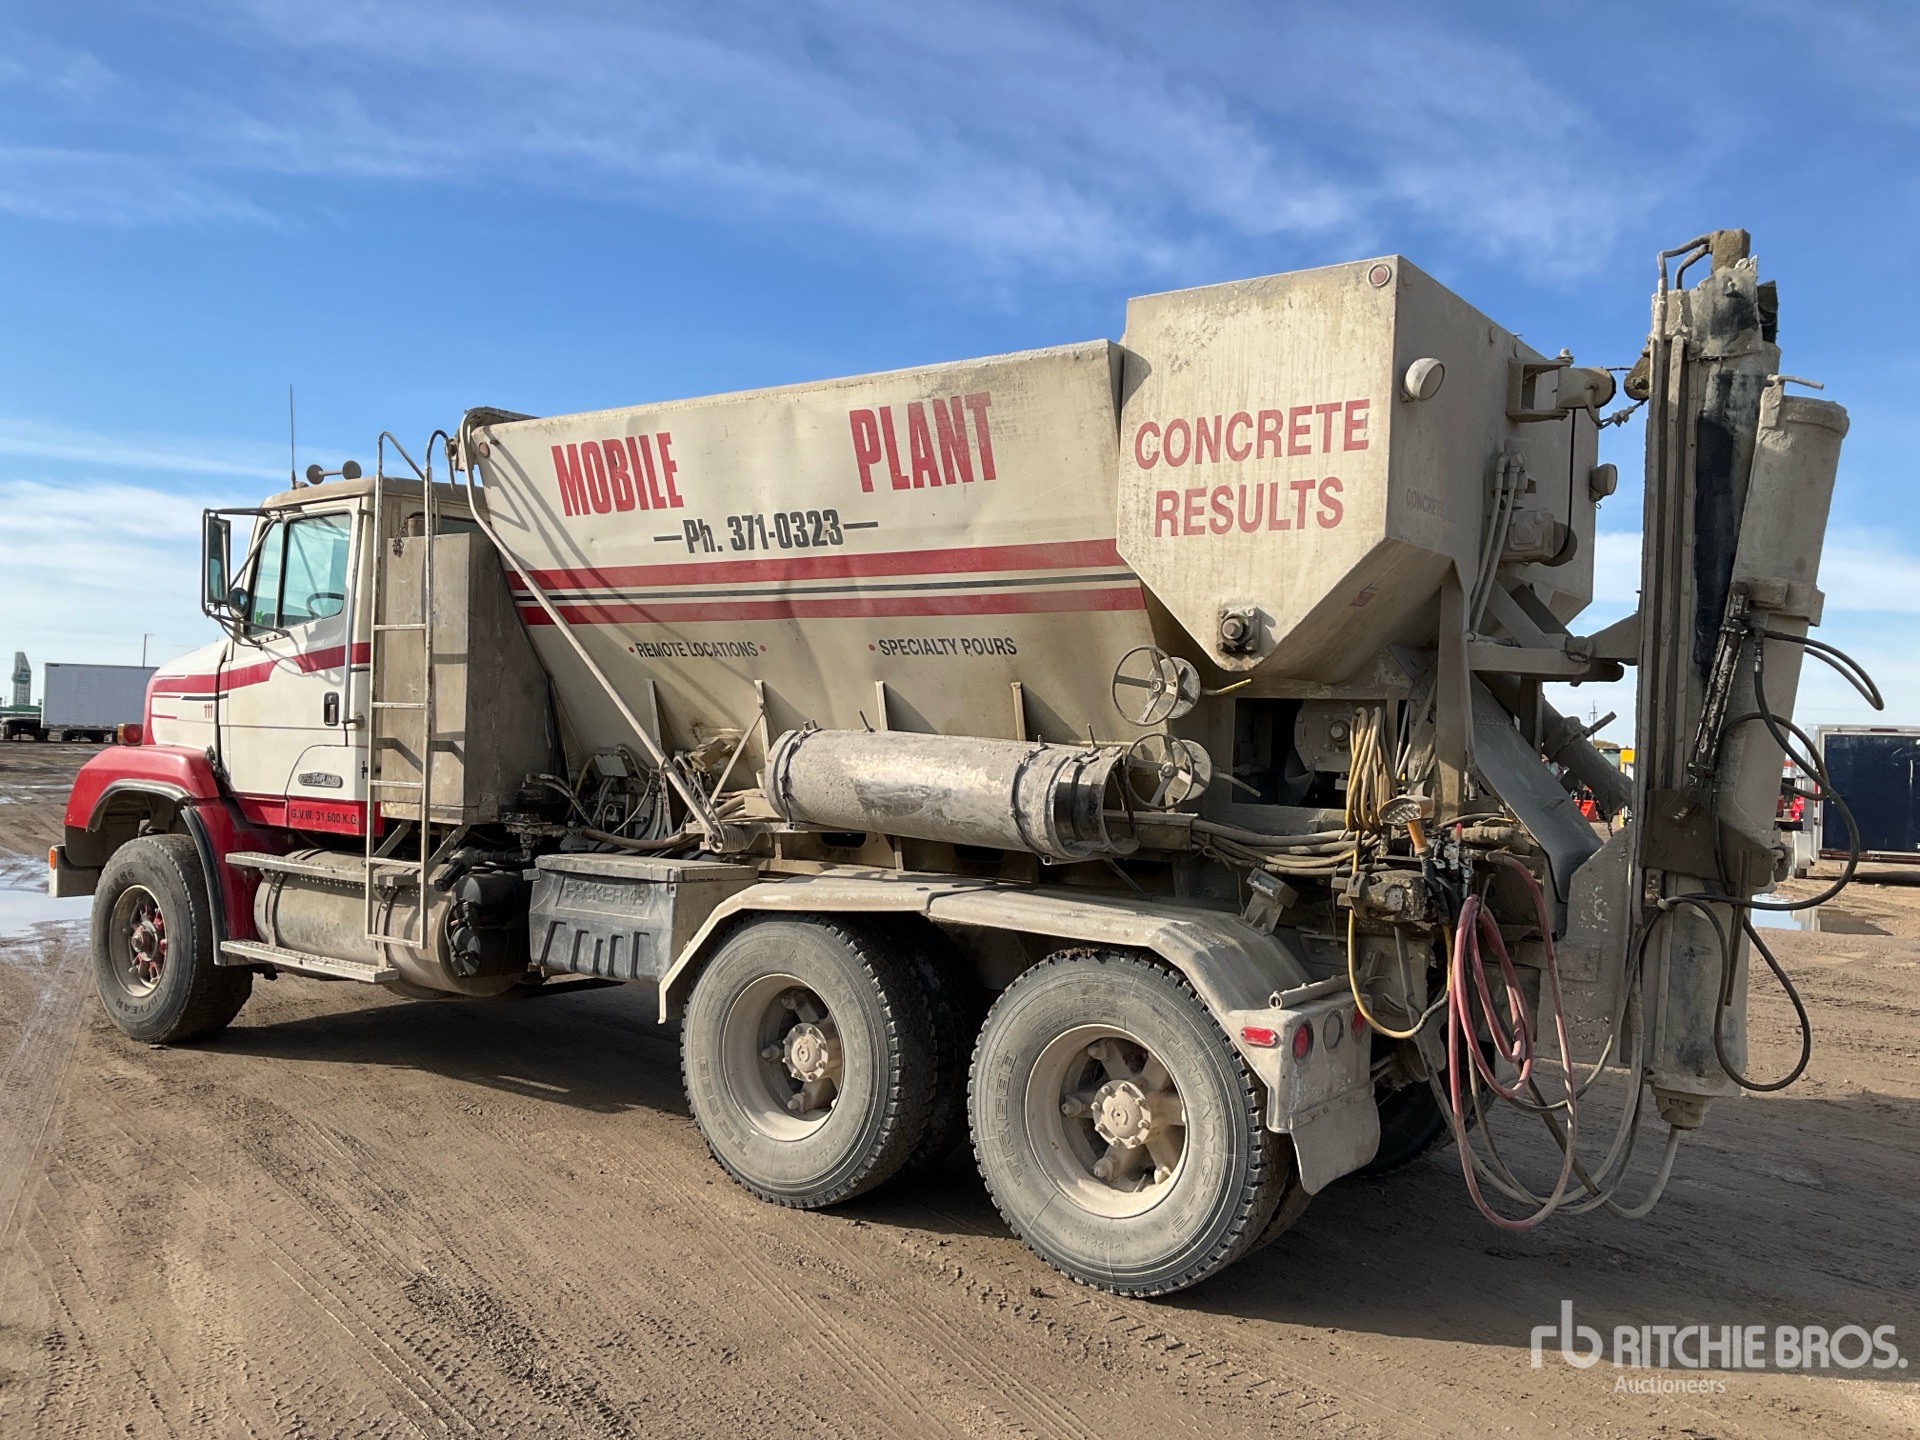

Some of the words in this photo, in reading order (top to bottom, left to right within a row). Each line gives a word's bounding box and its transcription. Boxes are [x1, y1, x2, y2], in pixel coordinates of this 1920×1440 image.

[551, 432, 684, 517] MOBILE
[848, 391, 997, 493] PLANT
[1134, 398, 1371, 470] CONCRETE
[1154, 476, 1344, 538] RESULTS
[683, 518, 724, 554] Ph.
[730, 509, 844, 552] 371-0323
[635, 641, 690, 658] REMOTE
[690, 641, 759, 658] LOCATIONS
[880, 637, 960, 657] SPECIALTY
[962, 637, 1018, 657] POURS
[203, 703, 213, 719] 111
